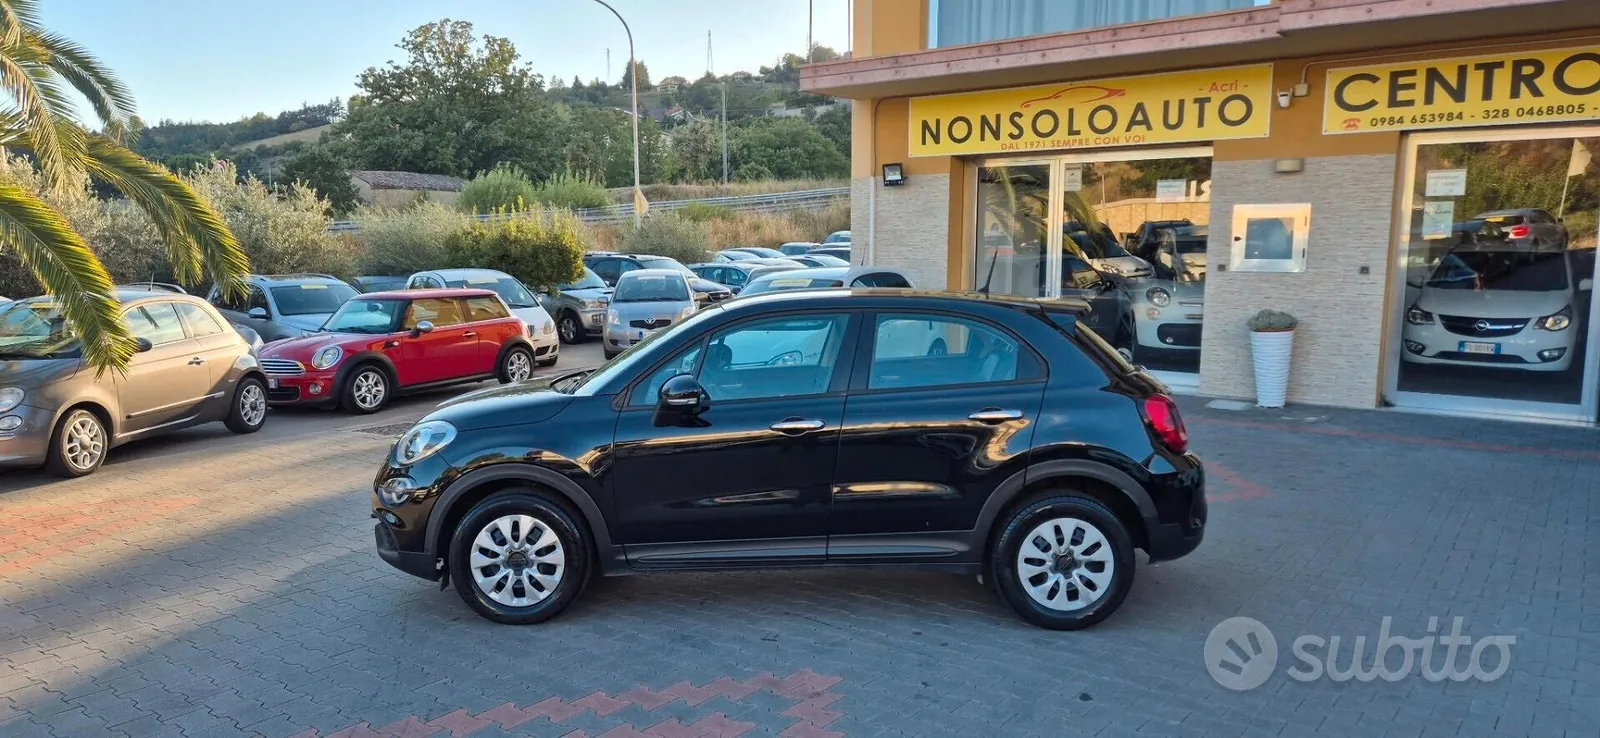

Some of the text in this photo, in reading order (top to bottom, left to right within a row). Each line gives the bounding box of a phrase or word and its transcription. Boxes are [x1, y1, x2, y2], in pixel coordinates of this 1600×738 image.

[1208, 79, 1239, 94] Acri
[1333, 52, 1600, 113] CENTRO
[921, 93, 1254, 146] NONSOLOAUTO
[1370, 115, 1405, 127] 0984
[1410, 111, 1464, 124] 653984
[1482, 108, 1510, 119] 328
[1516, 103, 1586, 118] 0468805
[1001, 134, 1145, 151] DAL 1971 SEMPRE CON VOI
